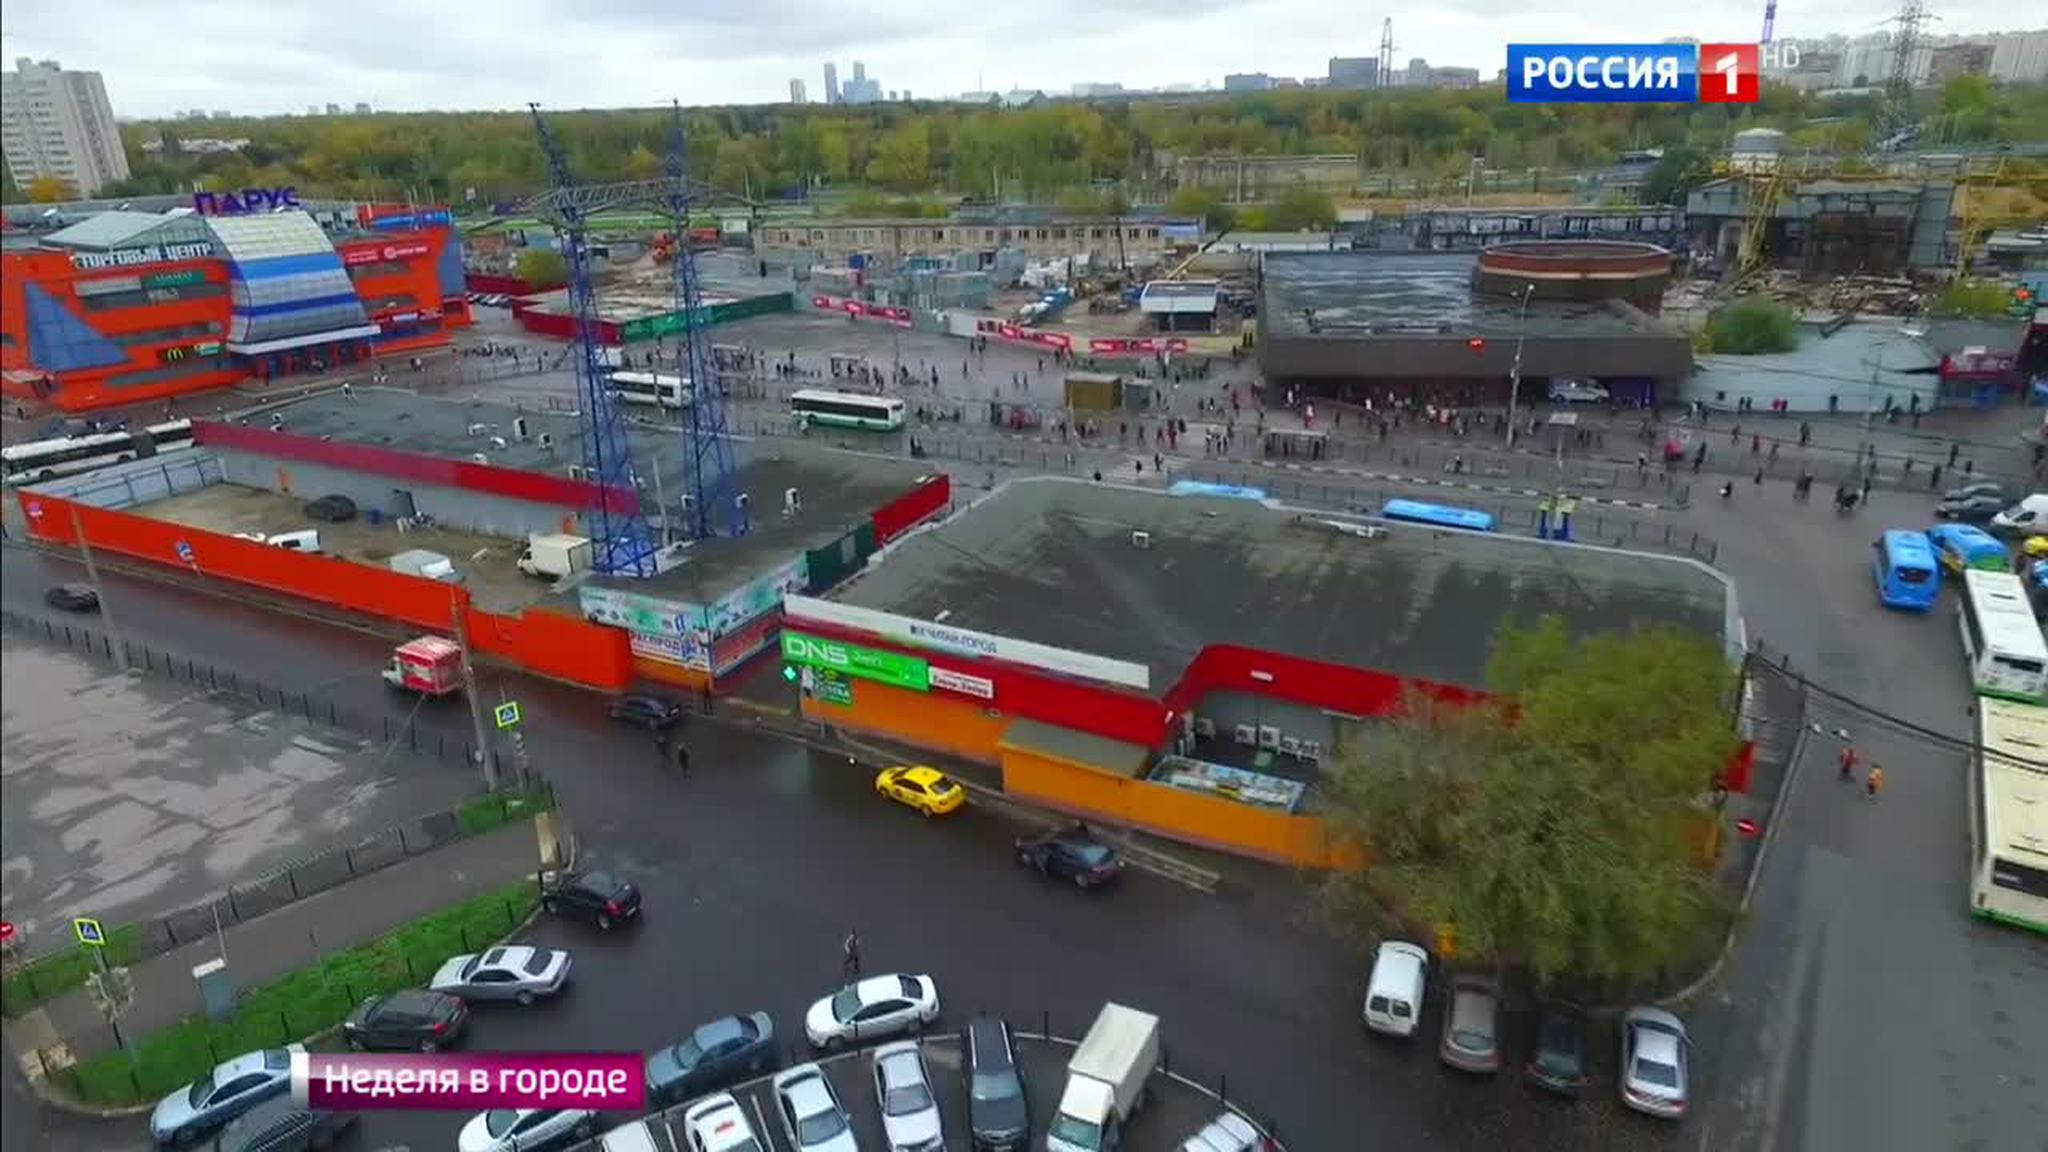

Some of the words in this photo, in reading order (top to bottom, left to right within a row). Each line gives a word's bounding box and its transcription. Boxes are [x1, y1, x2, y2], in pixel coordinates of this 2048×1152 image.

[194, 186, 300, 216] ПАРУС
[164, 242, 213, 262] ЦЕНТР
[785, 636, 849, 665] DNS
